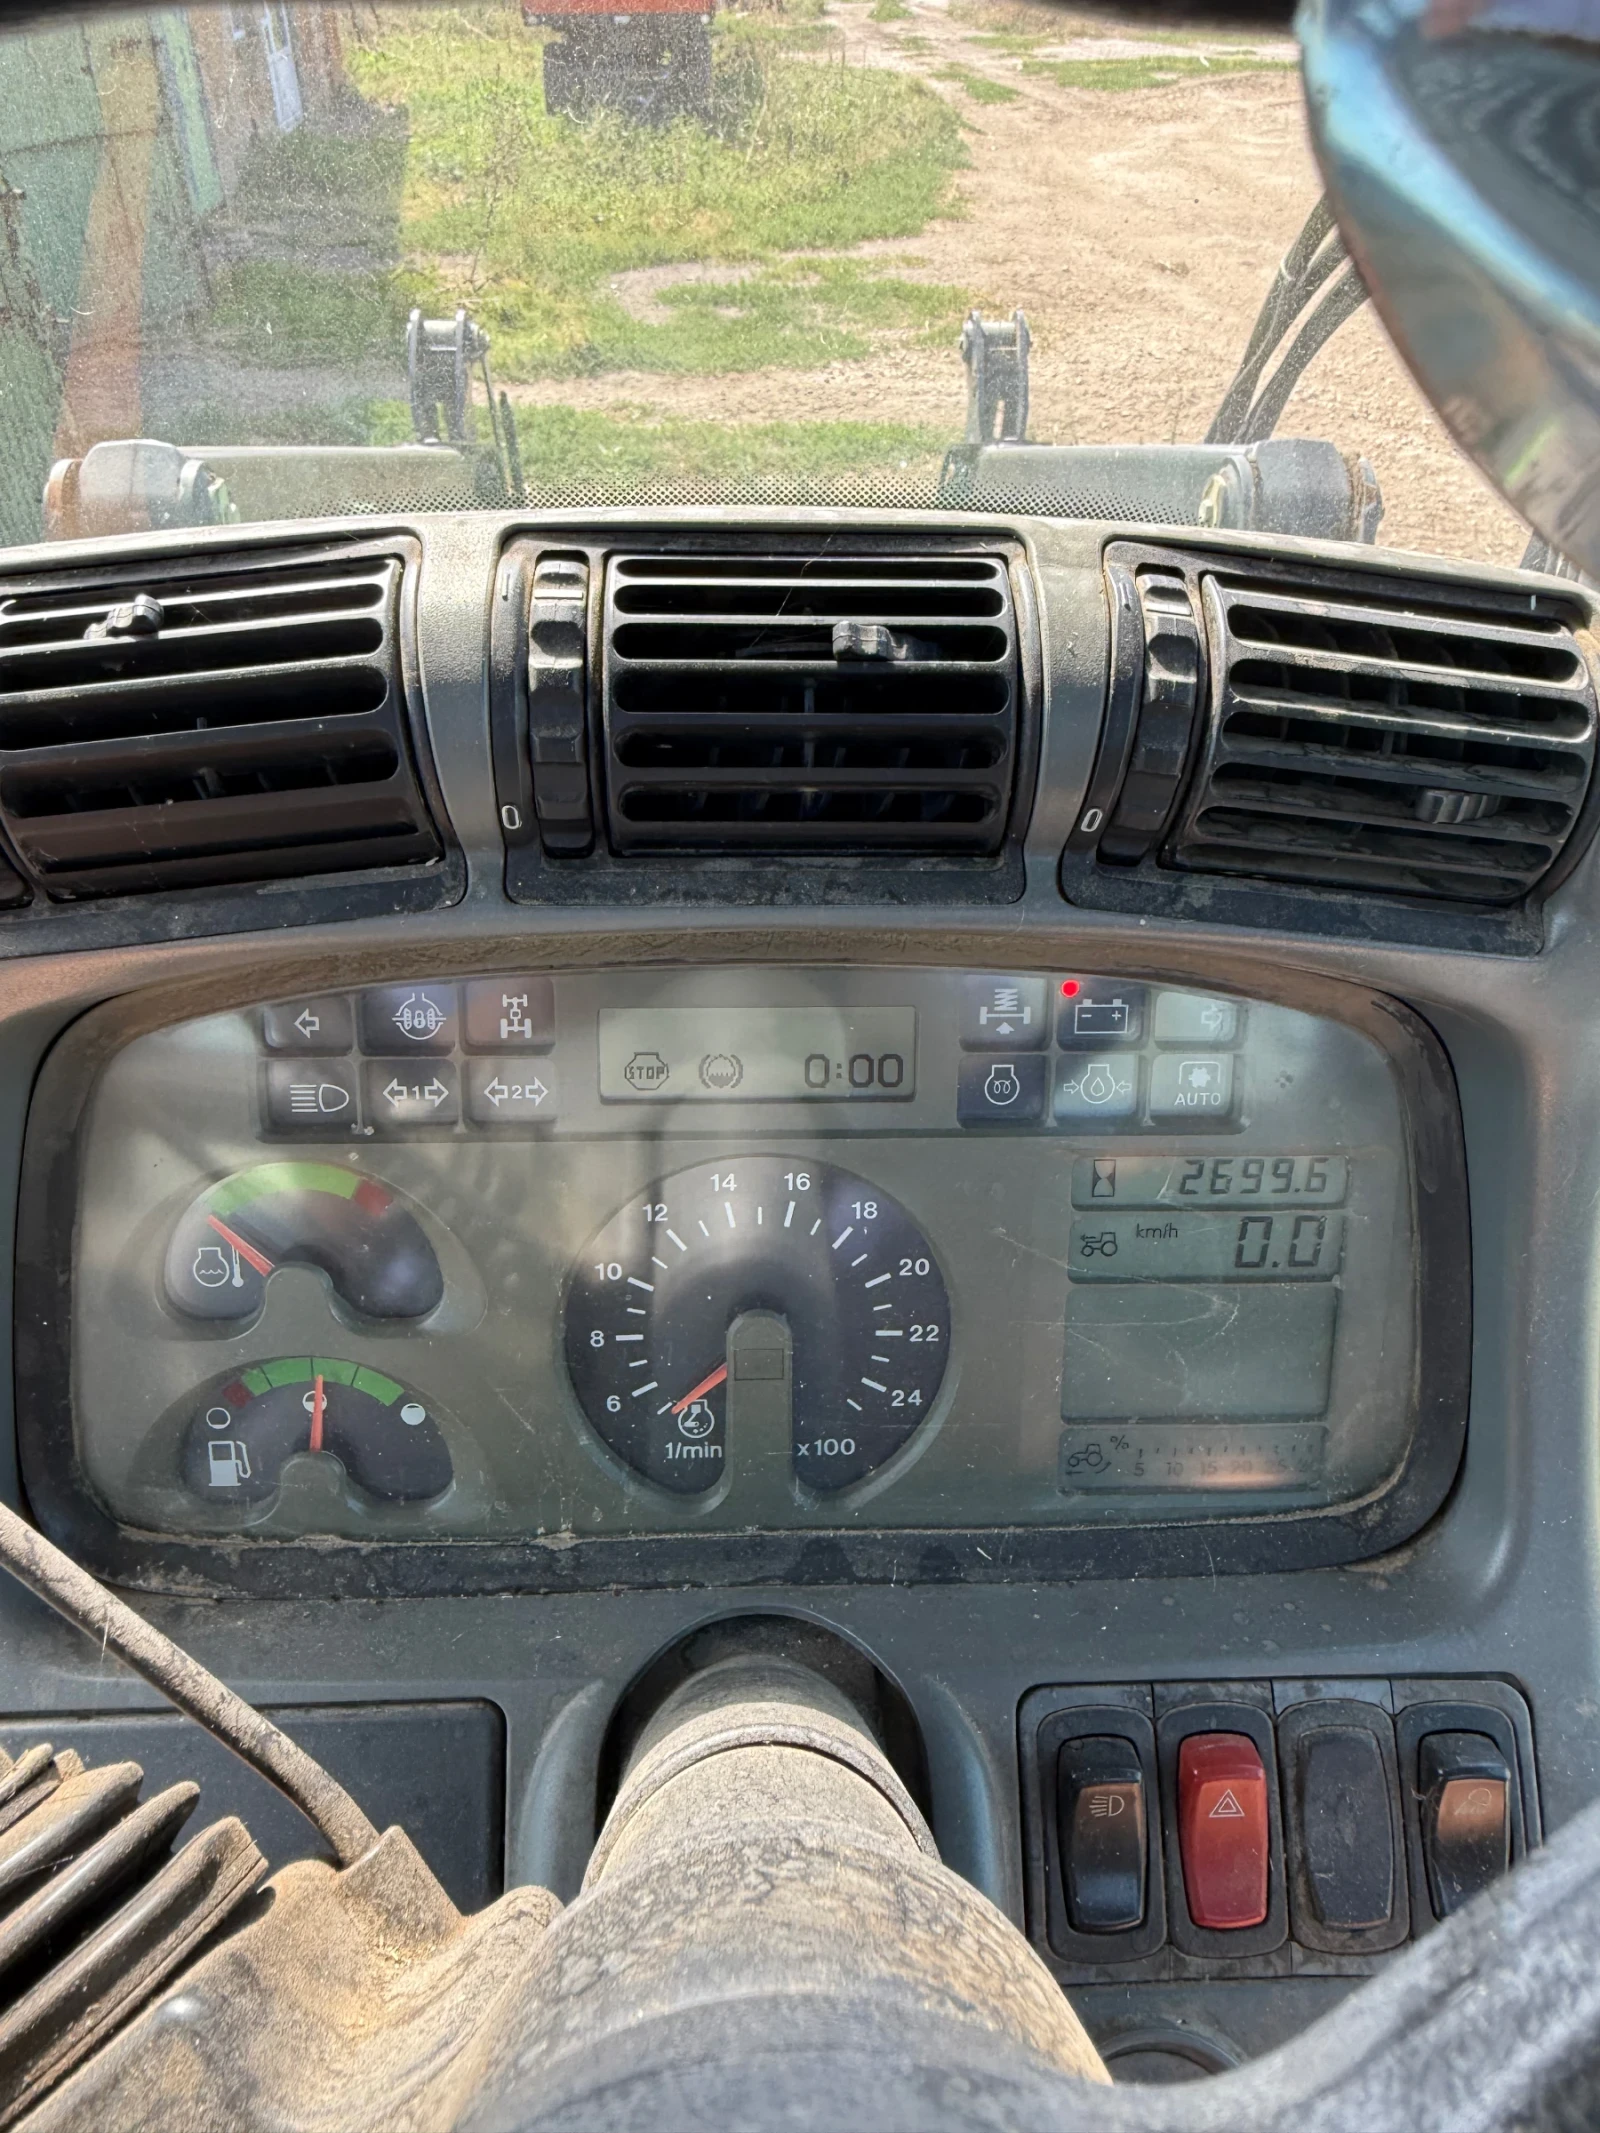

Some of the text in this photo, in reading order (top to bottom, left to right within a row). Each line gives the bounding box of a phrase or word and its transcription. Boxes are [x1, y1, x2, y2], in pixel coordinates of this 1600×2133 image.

[804, 1053, 904, 1089] 0:00
[411, 1085, 421, 1100] 1
[511, 1085, 523, 1100] 2
[1173, 1092, 1222, 1107] AUTO
[710, 1173, 737, 1191] 14
[784, 1172, 811, 1190] 16
[1178, 1157, 1330, 1195] 2699.6
[642, 1204, 668, 1222] 12
[851, 1202, 878, 1219] 18
[1135, 1222, 1179, 1239] km/h
[1234, 1215, 1328, 1268] 0.0
[594, 1262, 622, 1280] 10
[899, 1258, 930, 1275] 20
[590, 1331, 605, 1347] 8
[909, 1325, 940, 1342] 22
[606, 1396, 621, 1412] 6
[891, 1390, 923, 1407] 24
[665, 1442, 723, 1459] 1/min
[1133, 1462, 1145, 1477] 5
